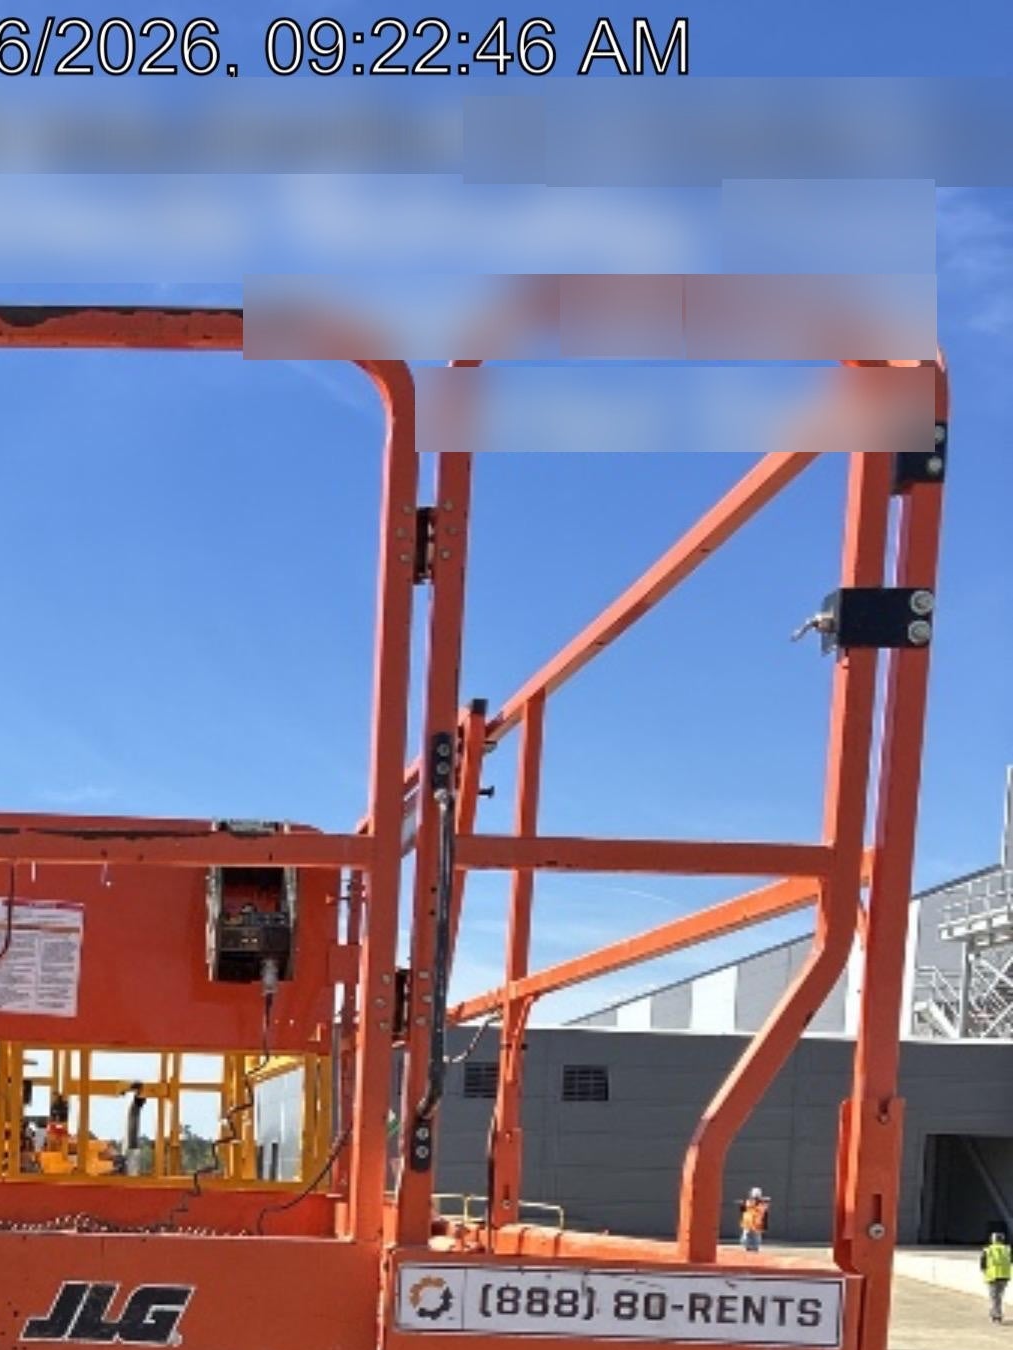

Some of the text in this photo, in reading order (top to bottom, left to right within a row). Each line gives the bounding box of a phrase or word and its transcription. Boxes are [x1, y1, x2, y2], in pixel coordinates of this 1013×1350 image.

[20, 1281, 196, 1346] JLG
[479, 1284, 822, 1328] (888) 80-RENTS
